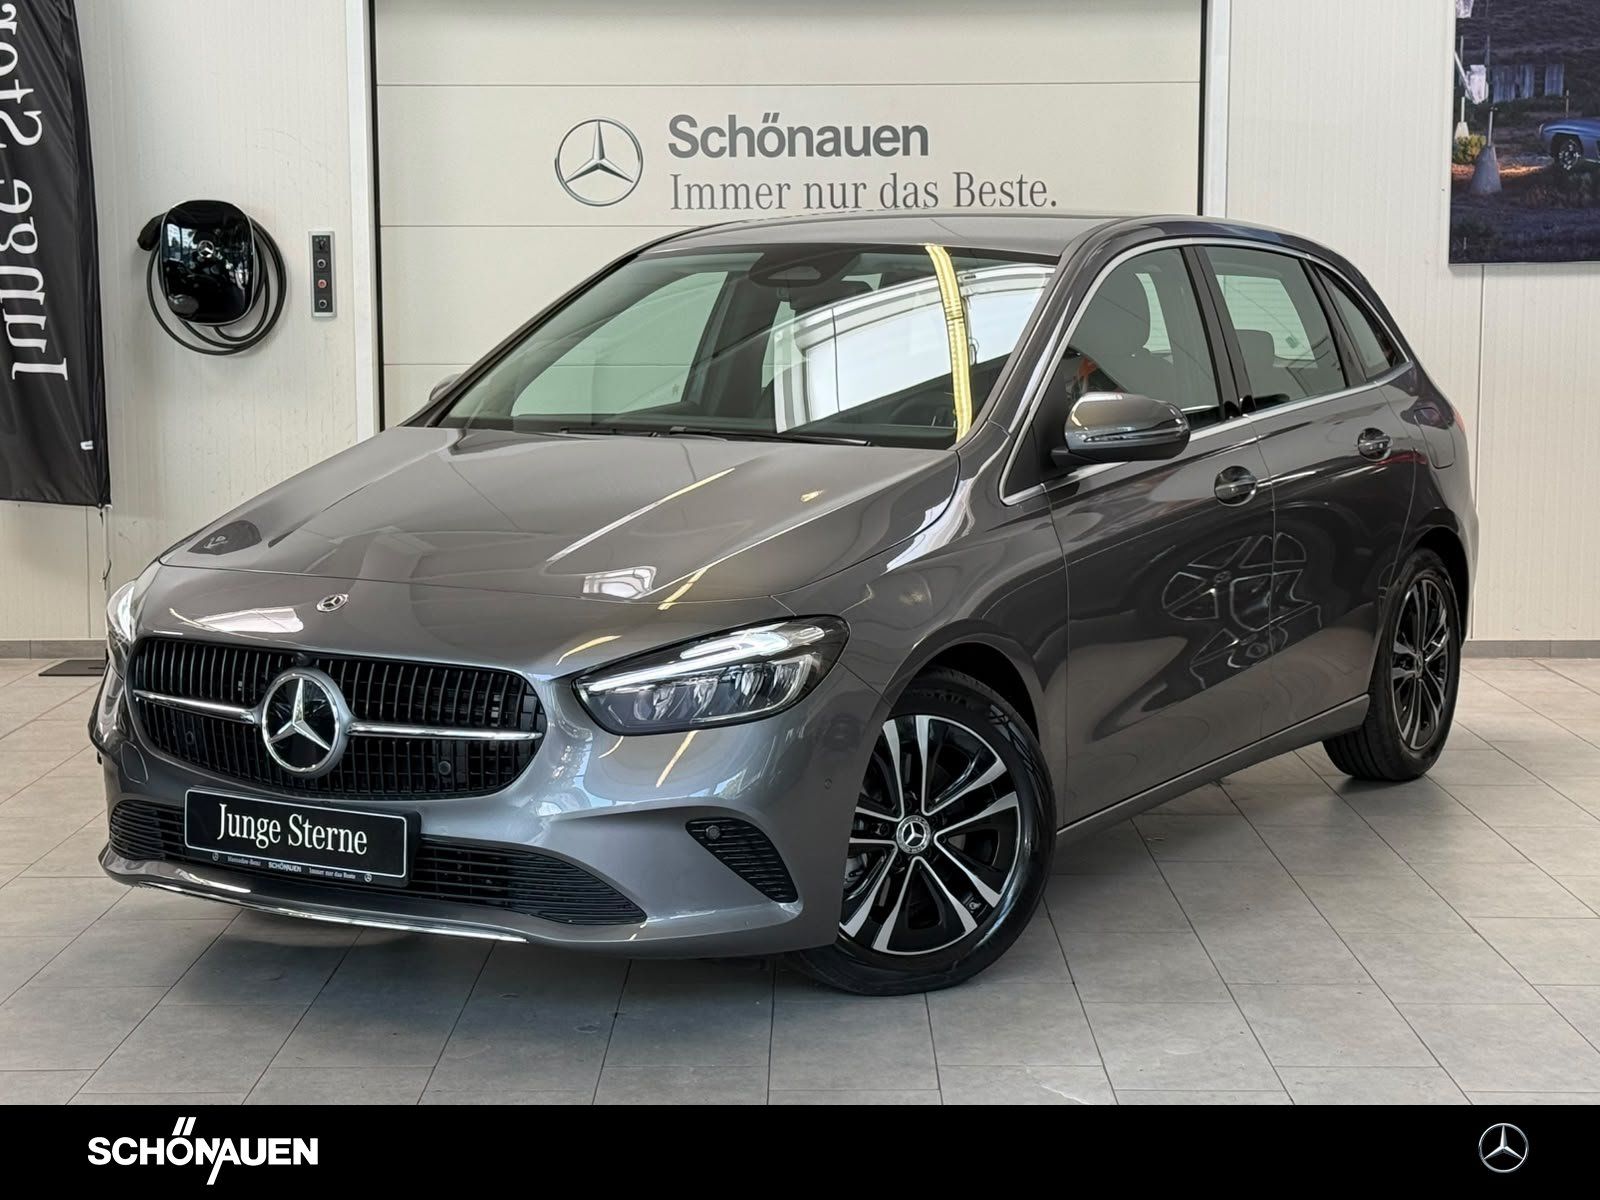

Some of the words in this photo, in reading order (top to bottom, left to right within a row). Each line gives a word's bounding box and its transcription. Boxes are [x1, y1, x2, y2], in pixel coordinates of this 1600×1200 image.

[668, 112, 929, 159] Schönauen
[670, 173, 792, 210] Immer
[803, 181, 867, 210] nur
[879, 172, 939, 209] das
[952, 171, 1057, 208] Beste.
[216, 803, 282, 849] Junge
[287, 813, 368, 855] Sterne
